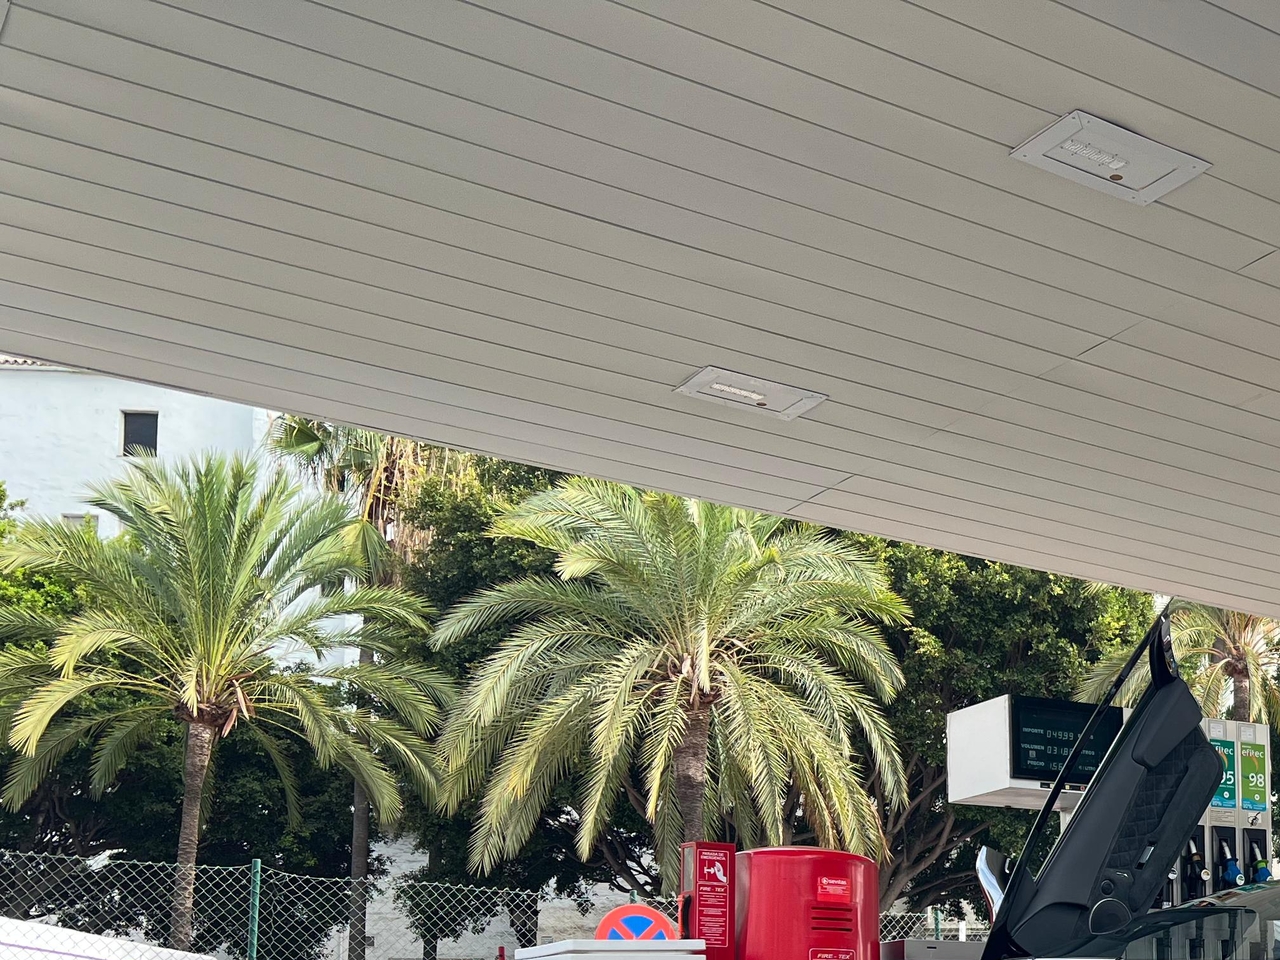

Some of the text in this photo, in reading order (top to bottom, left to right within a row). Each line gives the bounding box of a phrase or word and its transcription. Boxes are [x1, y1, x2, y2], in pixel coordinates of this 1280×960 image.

[1020, 743, 1045, 751] VOLUMEN
[1241, 748, 1264, 758] efitec
[1249, 773, 1264, 787] 98
